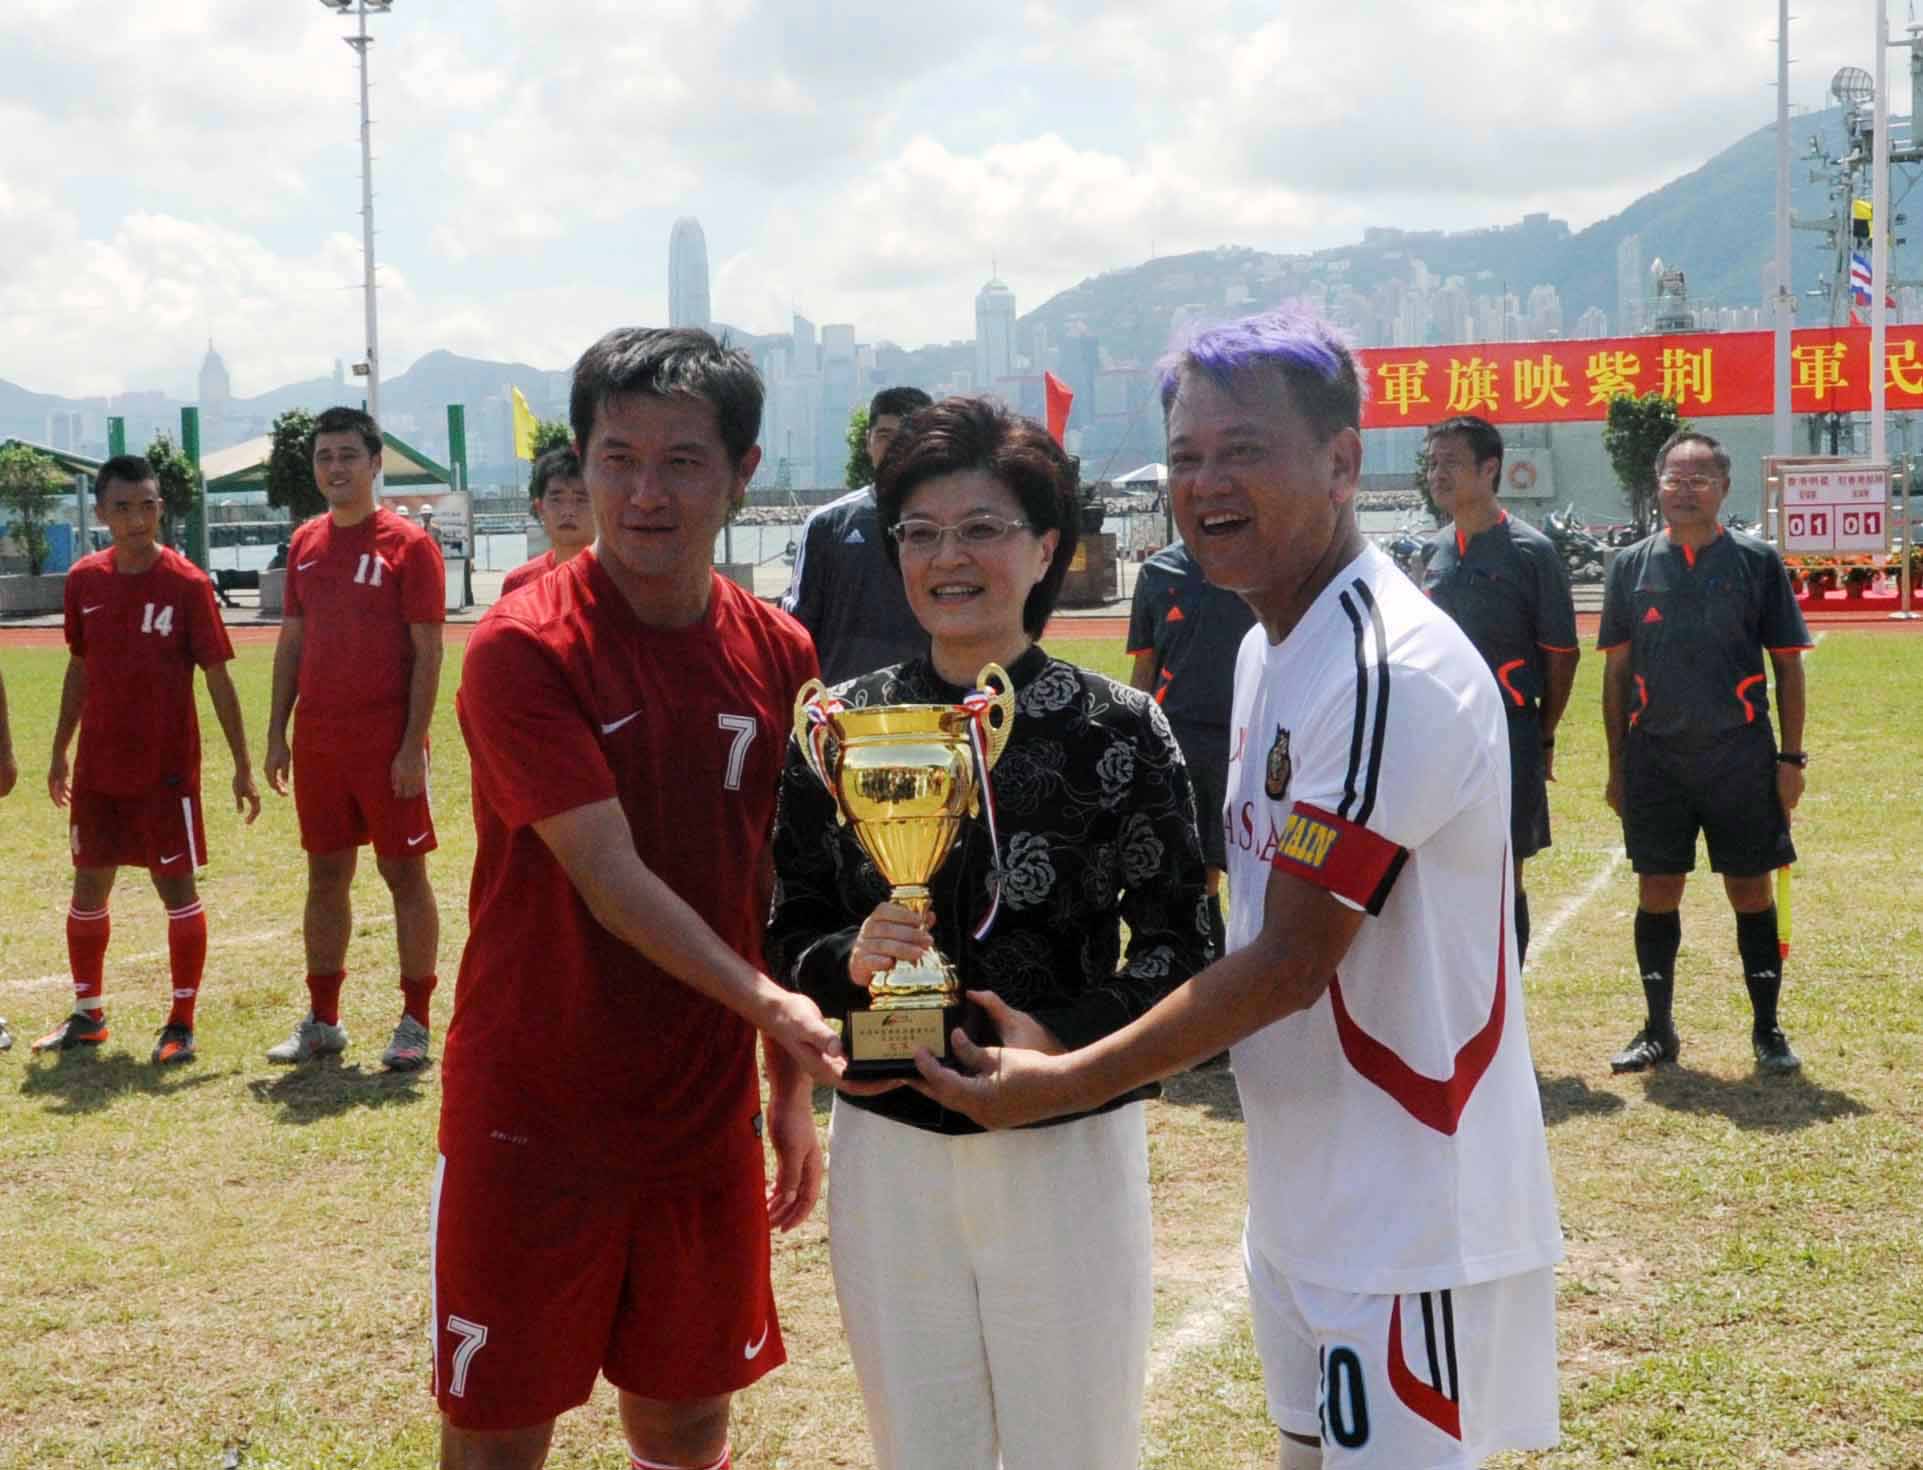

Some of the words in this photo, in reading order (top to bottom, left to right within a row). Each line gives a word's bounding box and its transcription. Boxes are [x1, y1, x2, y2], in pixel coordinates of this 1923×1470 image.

[1789, 515, 1826, 536] 01
[1844, 514, 1880, 534] 01
[353, 553, 384, 587] 11
[141, 603, 174, 637] 14
[718, 713, 757, 791] 7
[1224, 800, 1280, 862] ASA
[447, 1314, 488, 1398] 7
